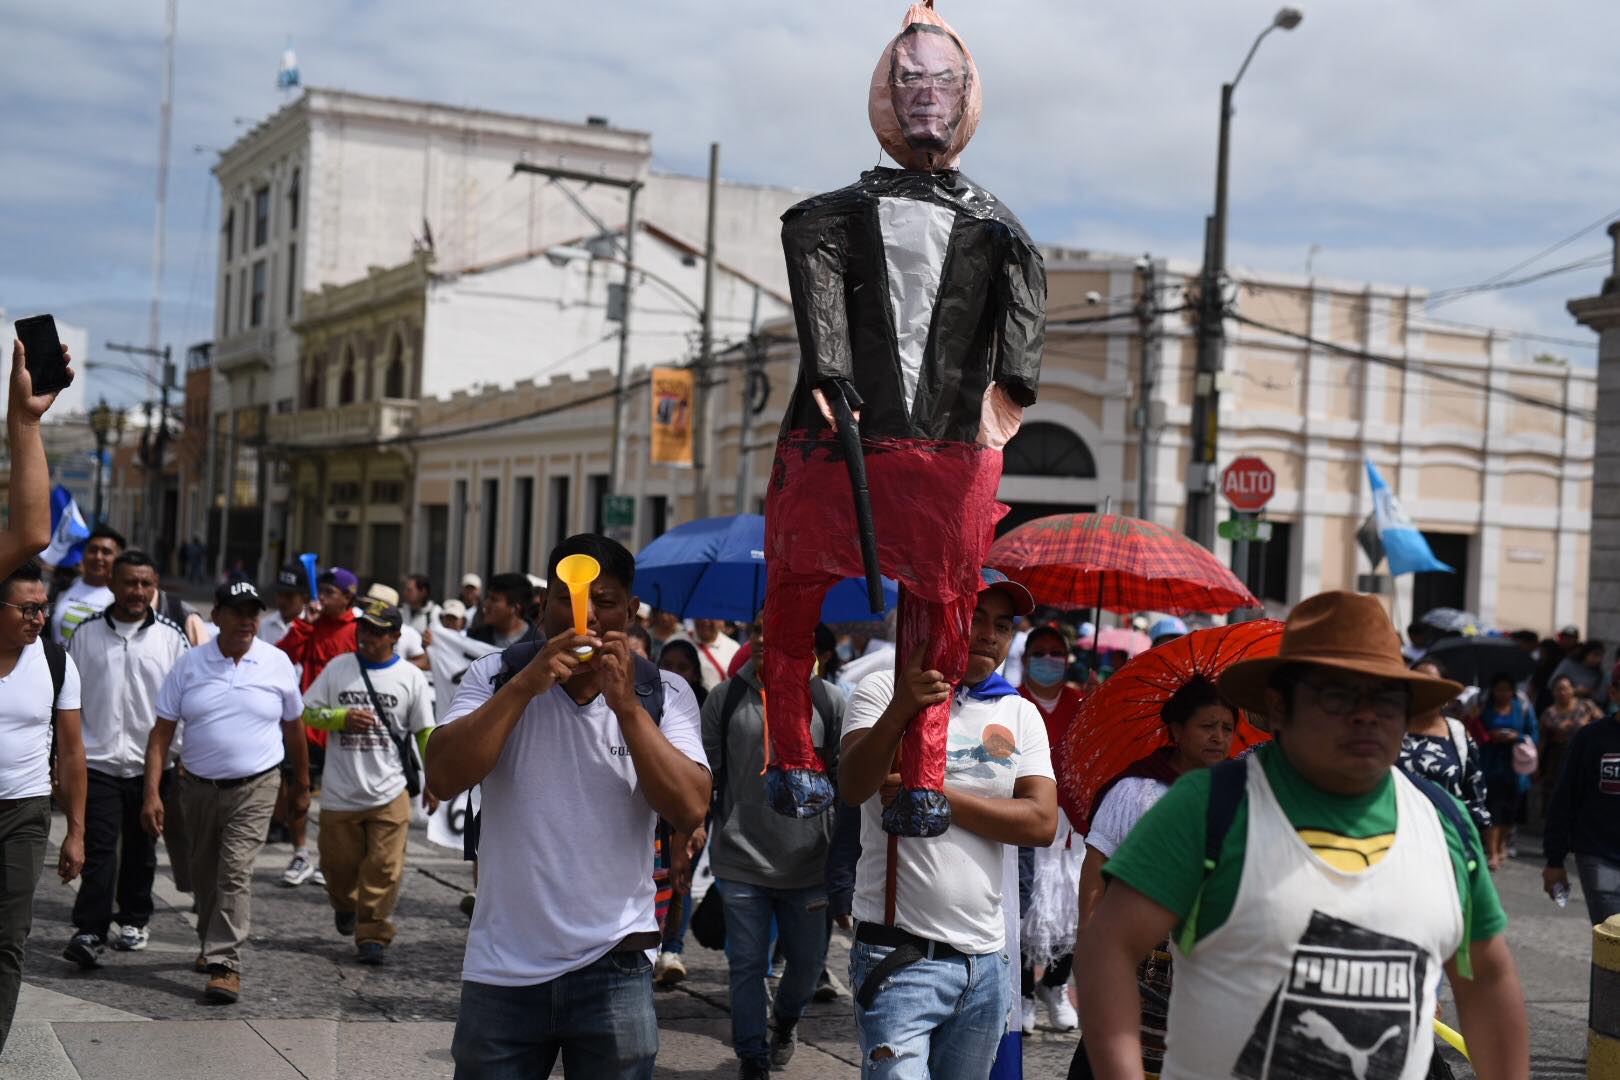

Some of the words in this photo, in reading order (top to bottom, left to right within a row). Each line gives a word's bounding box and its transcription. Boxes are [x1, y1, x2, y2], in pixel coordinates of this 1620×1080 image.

[1225, 470, 1272, 494] ALTO
[230, 582, 258, 597] UFC
[1293, 956, 1409, 998] PUMA
